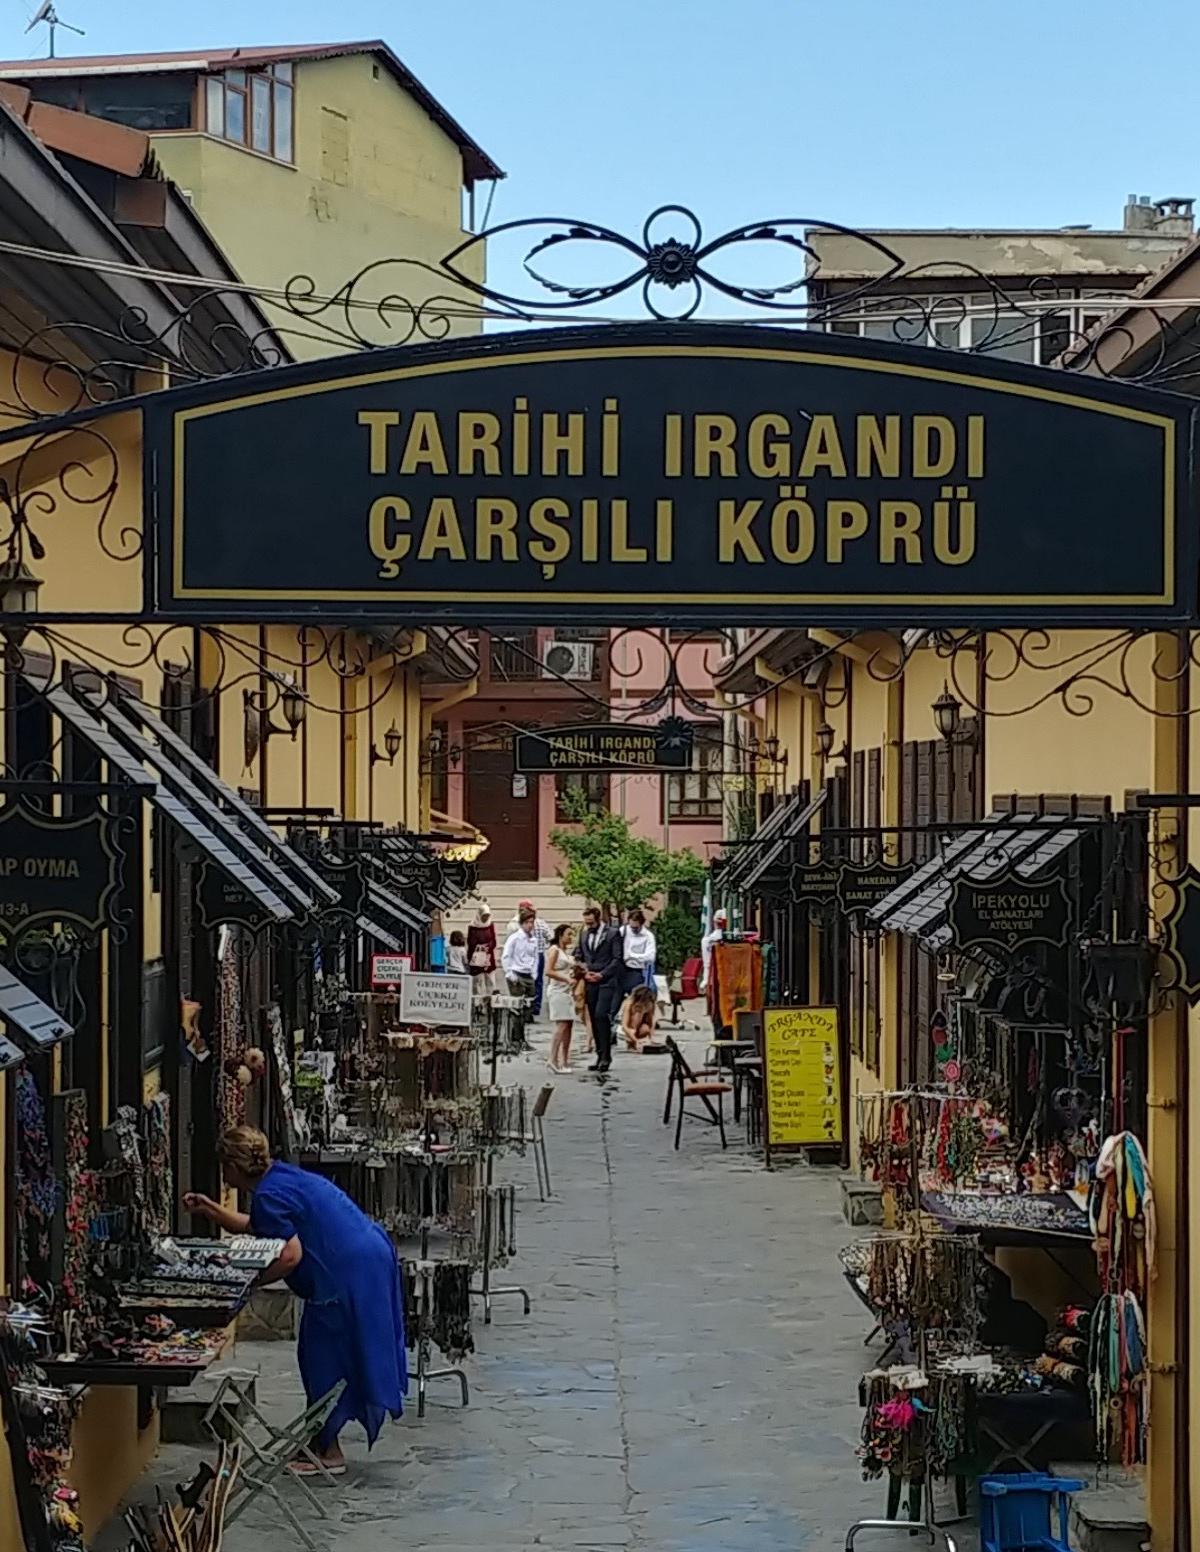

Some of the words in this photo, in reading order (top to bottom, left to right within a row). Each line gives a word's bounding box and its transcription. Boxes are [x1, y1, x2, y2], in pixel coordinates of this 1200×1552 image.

[357, 396, 620, 477] TARİHİ
[664, 412, 985, 479] IRGANDI
[367, 495, 674, 580] ÇARŞILI
[717, 484, 977, 566] KÖPRÜ
[549, 734, 594, 749] TARİHİ
[549, 750, 604, 767] ÇARŞILI
[608, 749, 656, 764] KÖPRÜ
[23, 857, 80, 878] OYMA
[971, 891, 1050, 909] İPEKYOLU
[1007, 931, 1019, 947] 9
